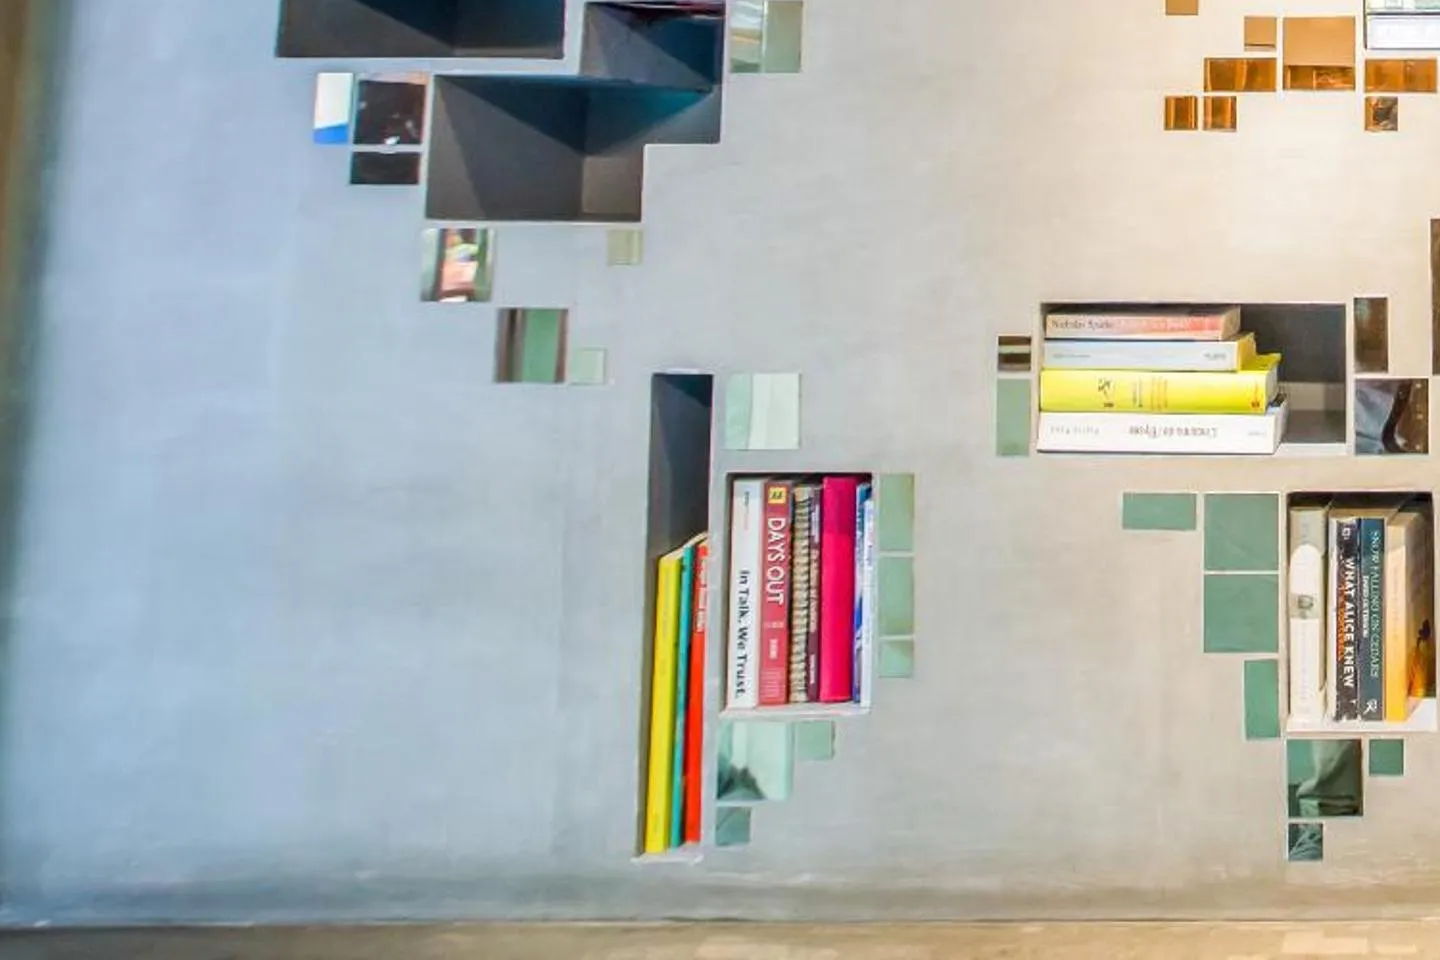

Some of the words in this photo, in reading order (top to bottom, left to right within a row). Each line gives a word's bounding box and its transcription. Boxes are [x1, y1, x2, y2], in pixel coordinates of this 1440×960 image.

[766, 517, 787, 562] DAYS
[739, 570, 750, 584] In
[766, 565, 784, 606] OUT
[1344, 556, 1357, 599] WHAT
[736, 627, 748, 651] We
[1344, 602, 1355, 641] ALICE
[1343, 646, 1355, 689] KNEW
